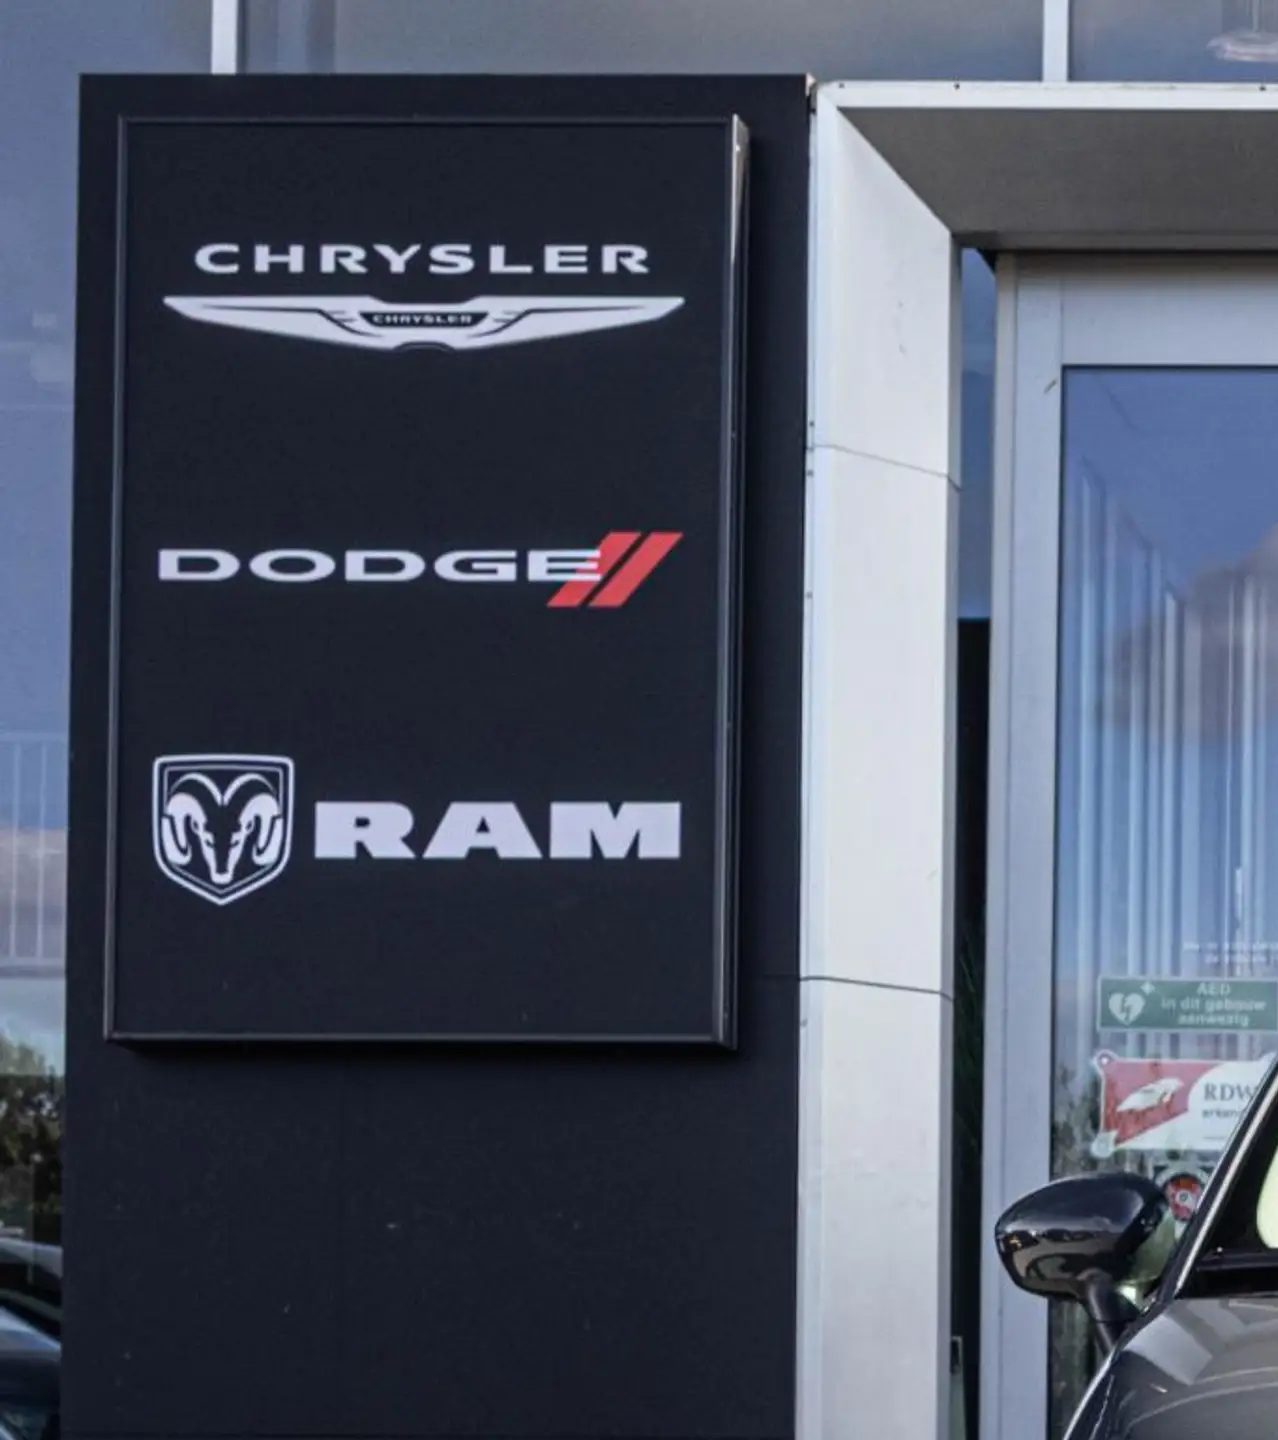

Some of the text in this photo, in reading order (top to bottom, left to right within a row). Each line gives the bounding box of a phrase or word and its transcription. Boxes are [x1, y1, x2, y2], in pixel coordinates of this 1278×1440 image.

[195, 243, 650, 275] CHRYSLER
[158, 548, 603, 582] DODGE
[314, 801, 682, 859] RAM
[1196, 982, 1231, 996] AED
